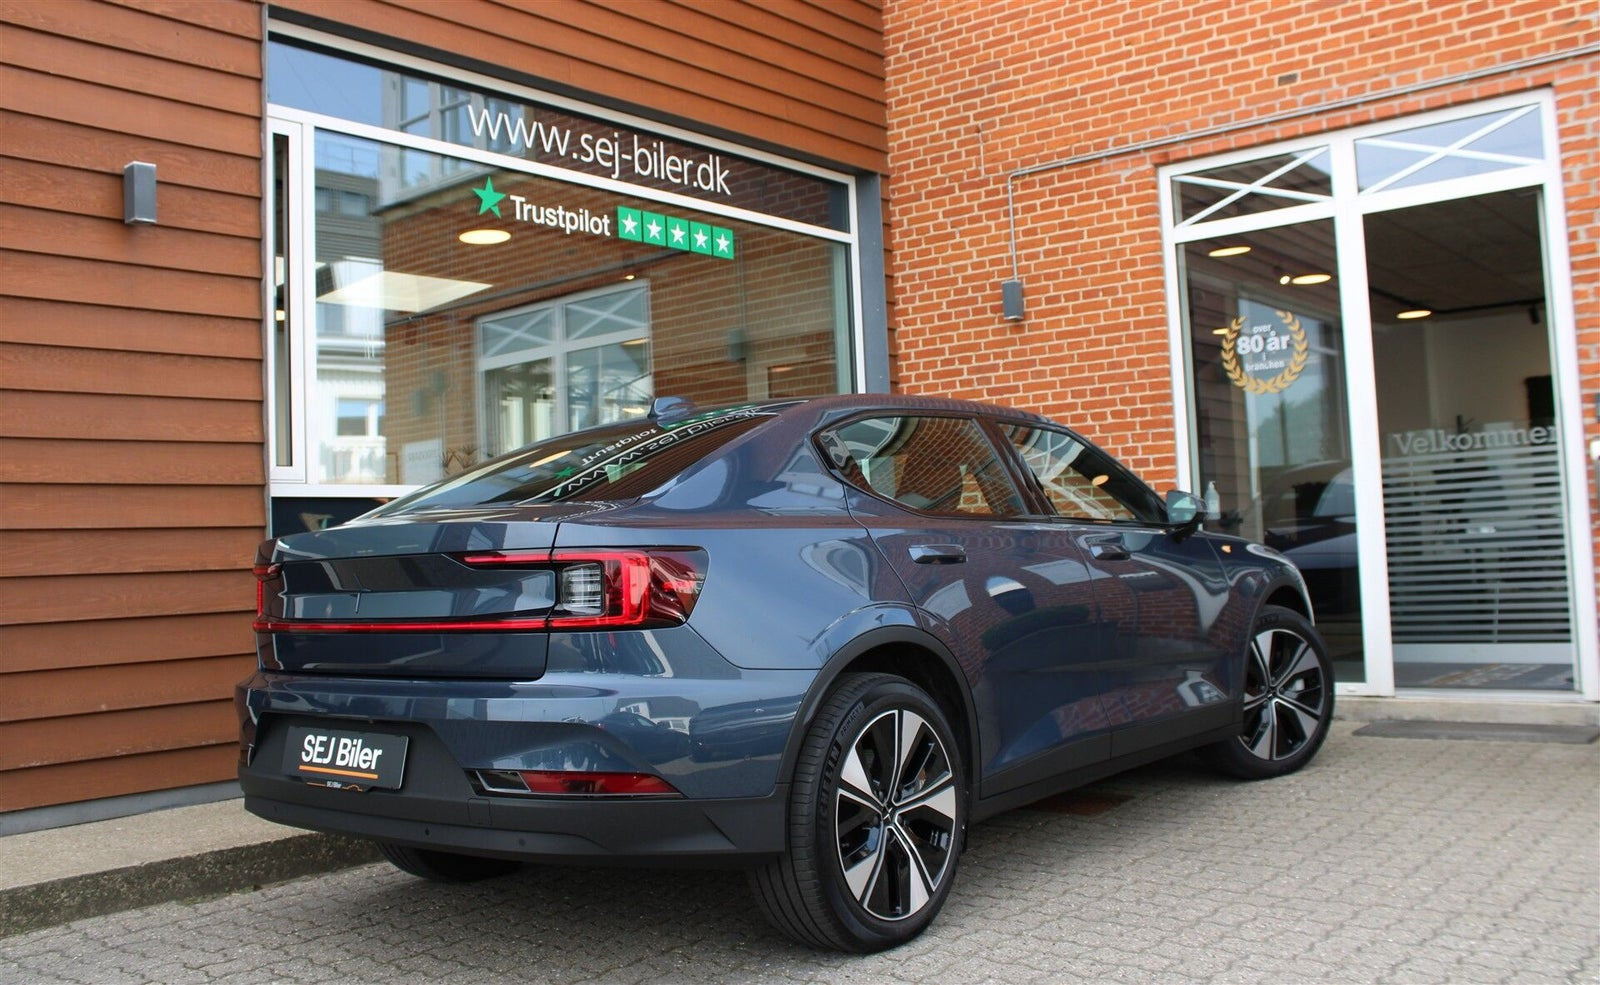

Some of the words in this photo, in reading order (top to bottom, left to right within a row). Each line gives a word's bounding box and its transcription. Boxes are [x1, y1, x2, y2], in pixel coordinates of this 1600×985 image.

[467, 104, 731, 196] www.sej-biler.dk
[510, 195, 611, 236] Trustpilot
[1237, 334, 1265, 355] 80
[1266, 330, 1290, 351] år
[1252, 324, 1272, 334] over
[301, 734, 336, 764] SEJ
[335, 737, 383, 770] Biler
